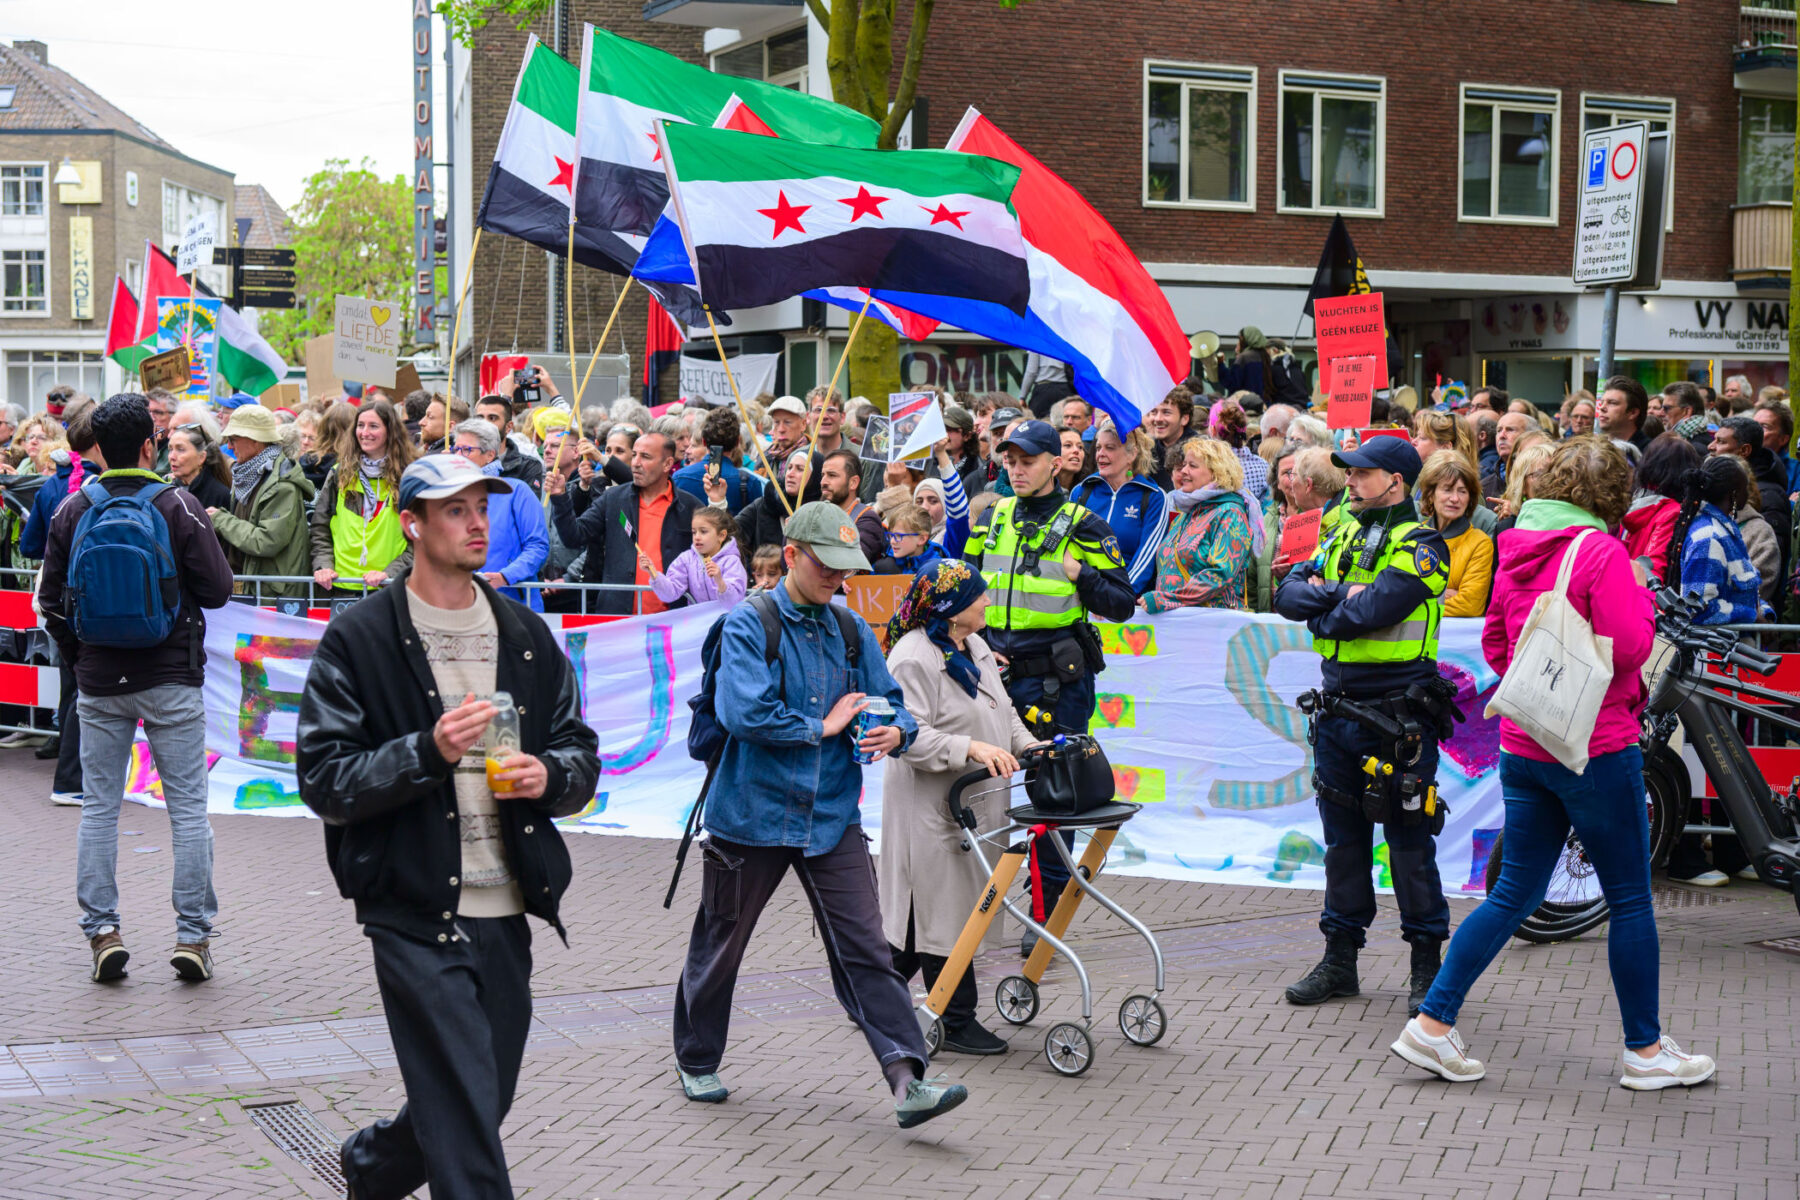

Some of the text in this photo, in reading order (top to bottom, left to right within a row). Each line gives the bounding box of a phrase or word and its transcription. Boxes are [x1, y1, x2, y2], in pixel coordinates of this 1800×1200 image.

[1592, 151, 1604, 172] P
[1586, 192, 1632, 206] uitgezonderd
[1582, 233, 1600, 242] laden
[1608, 230, 1631, 239] lossen
[1582, 253, 1627, 266] uitgezonderd
[1577, 264, 1630, 278] tijdens de markt
[1319, 303, 1379, 318] VLUCHTEN IS
[1695, 300, 1733, 329] VY
[340, 319, 395, 347] LIEFDE
[1349, 323, 1380, 335] KEUZE
[1669, 328, 1723, 340] Professional
[1724, 330, 1741, 340] Nail
[1742, 330, 1764, 341] Care
[1764, 330, 1778, 341] For
[1509, 338, 1543, 348] VY NAILS
[1705, 733, 1732, 776] CUBE
